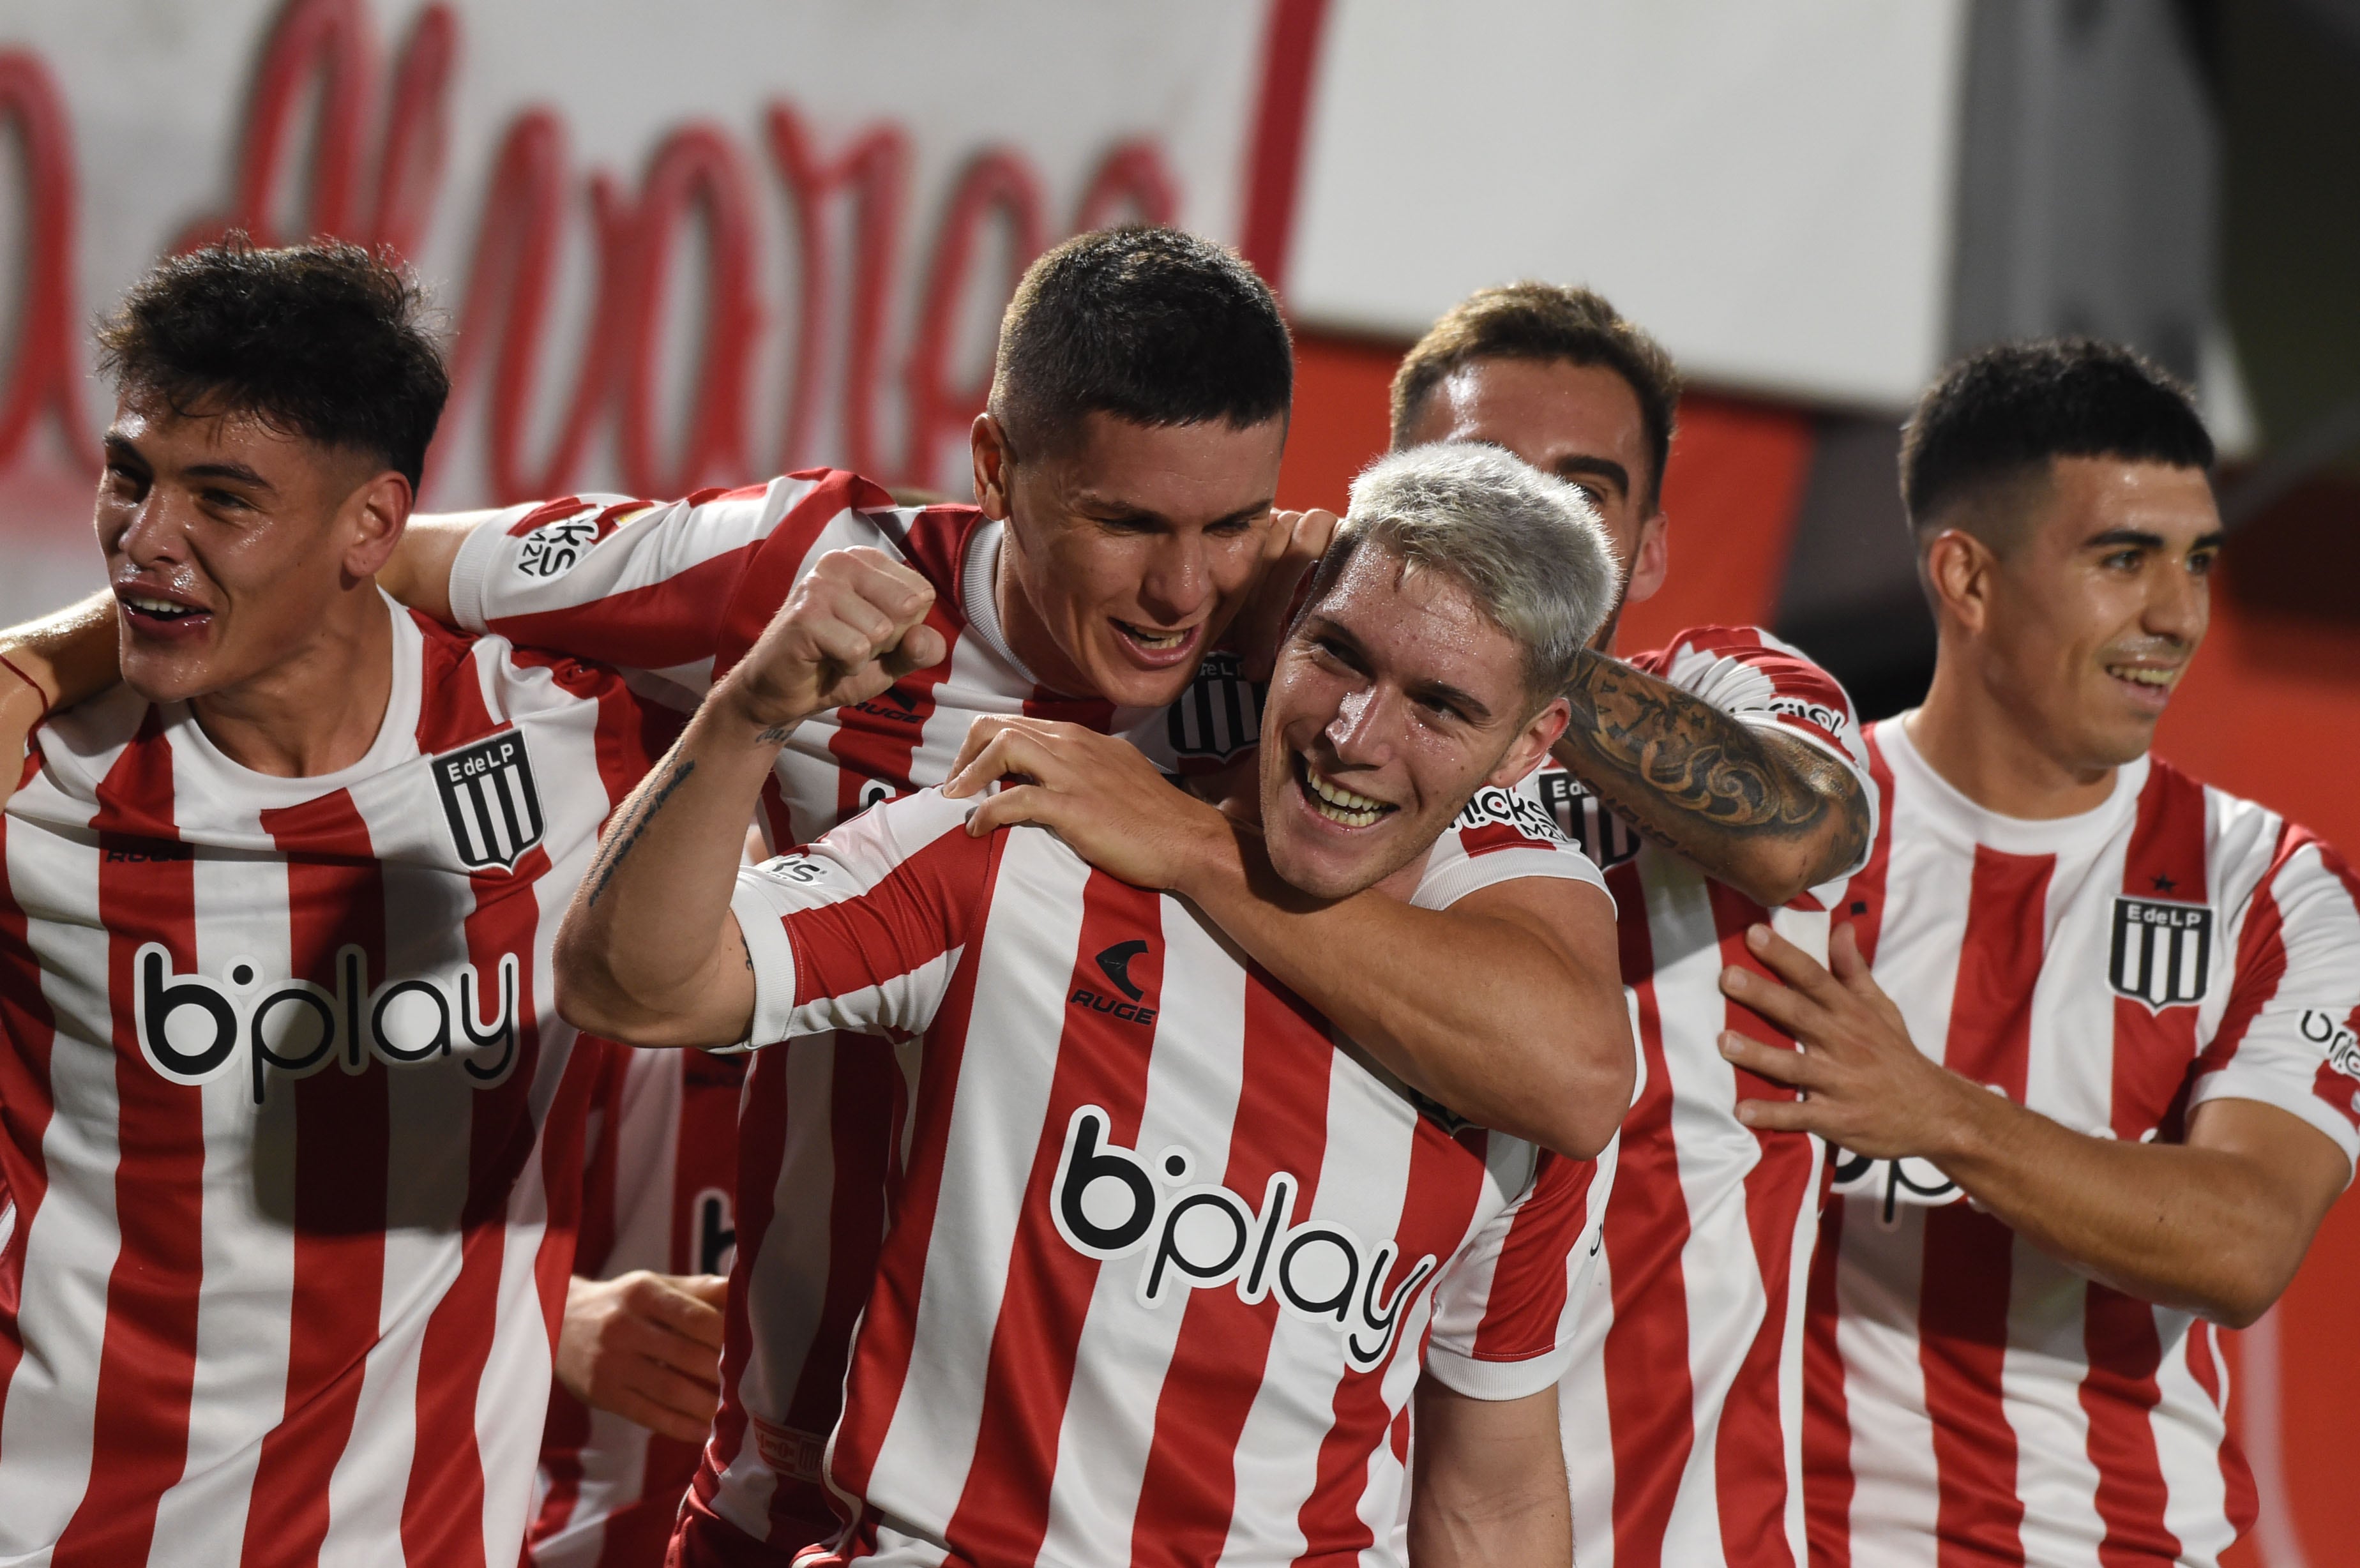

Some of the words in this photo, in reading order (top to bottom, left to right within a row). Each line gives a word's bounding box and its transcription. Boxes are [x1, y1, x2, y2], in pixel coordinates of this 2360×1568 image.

[144, 952, 514, 1105] bplay
[1070, 989, 1157, 1025] RUGE
[1061, 1115, 1430, 1364] bplay
